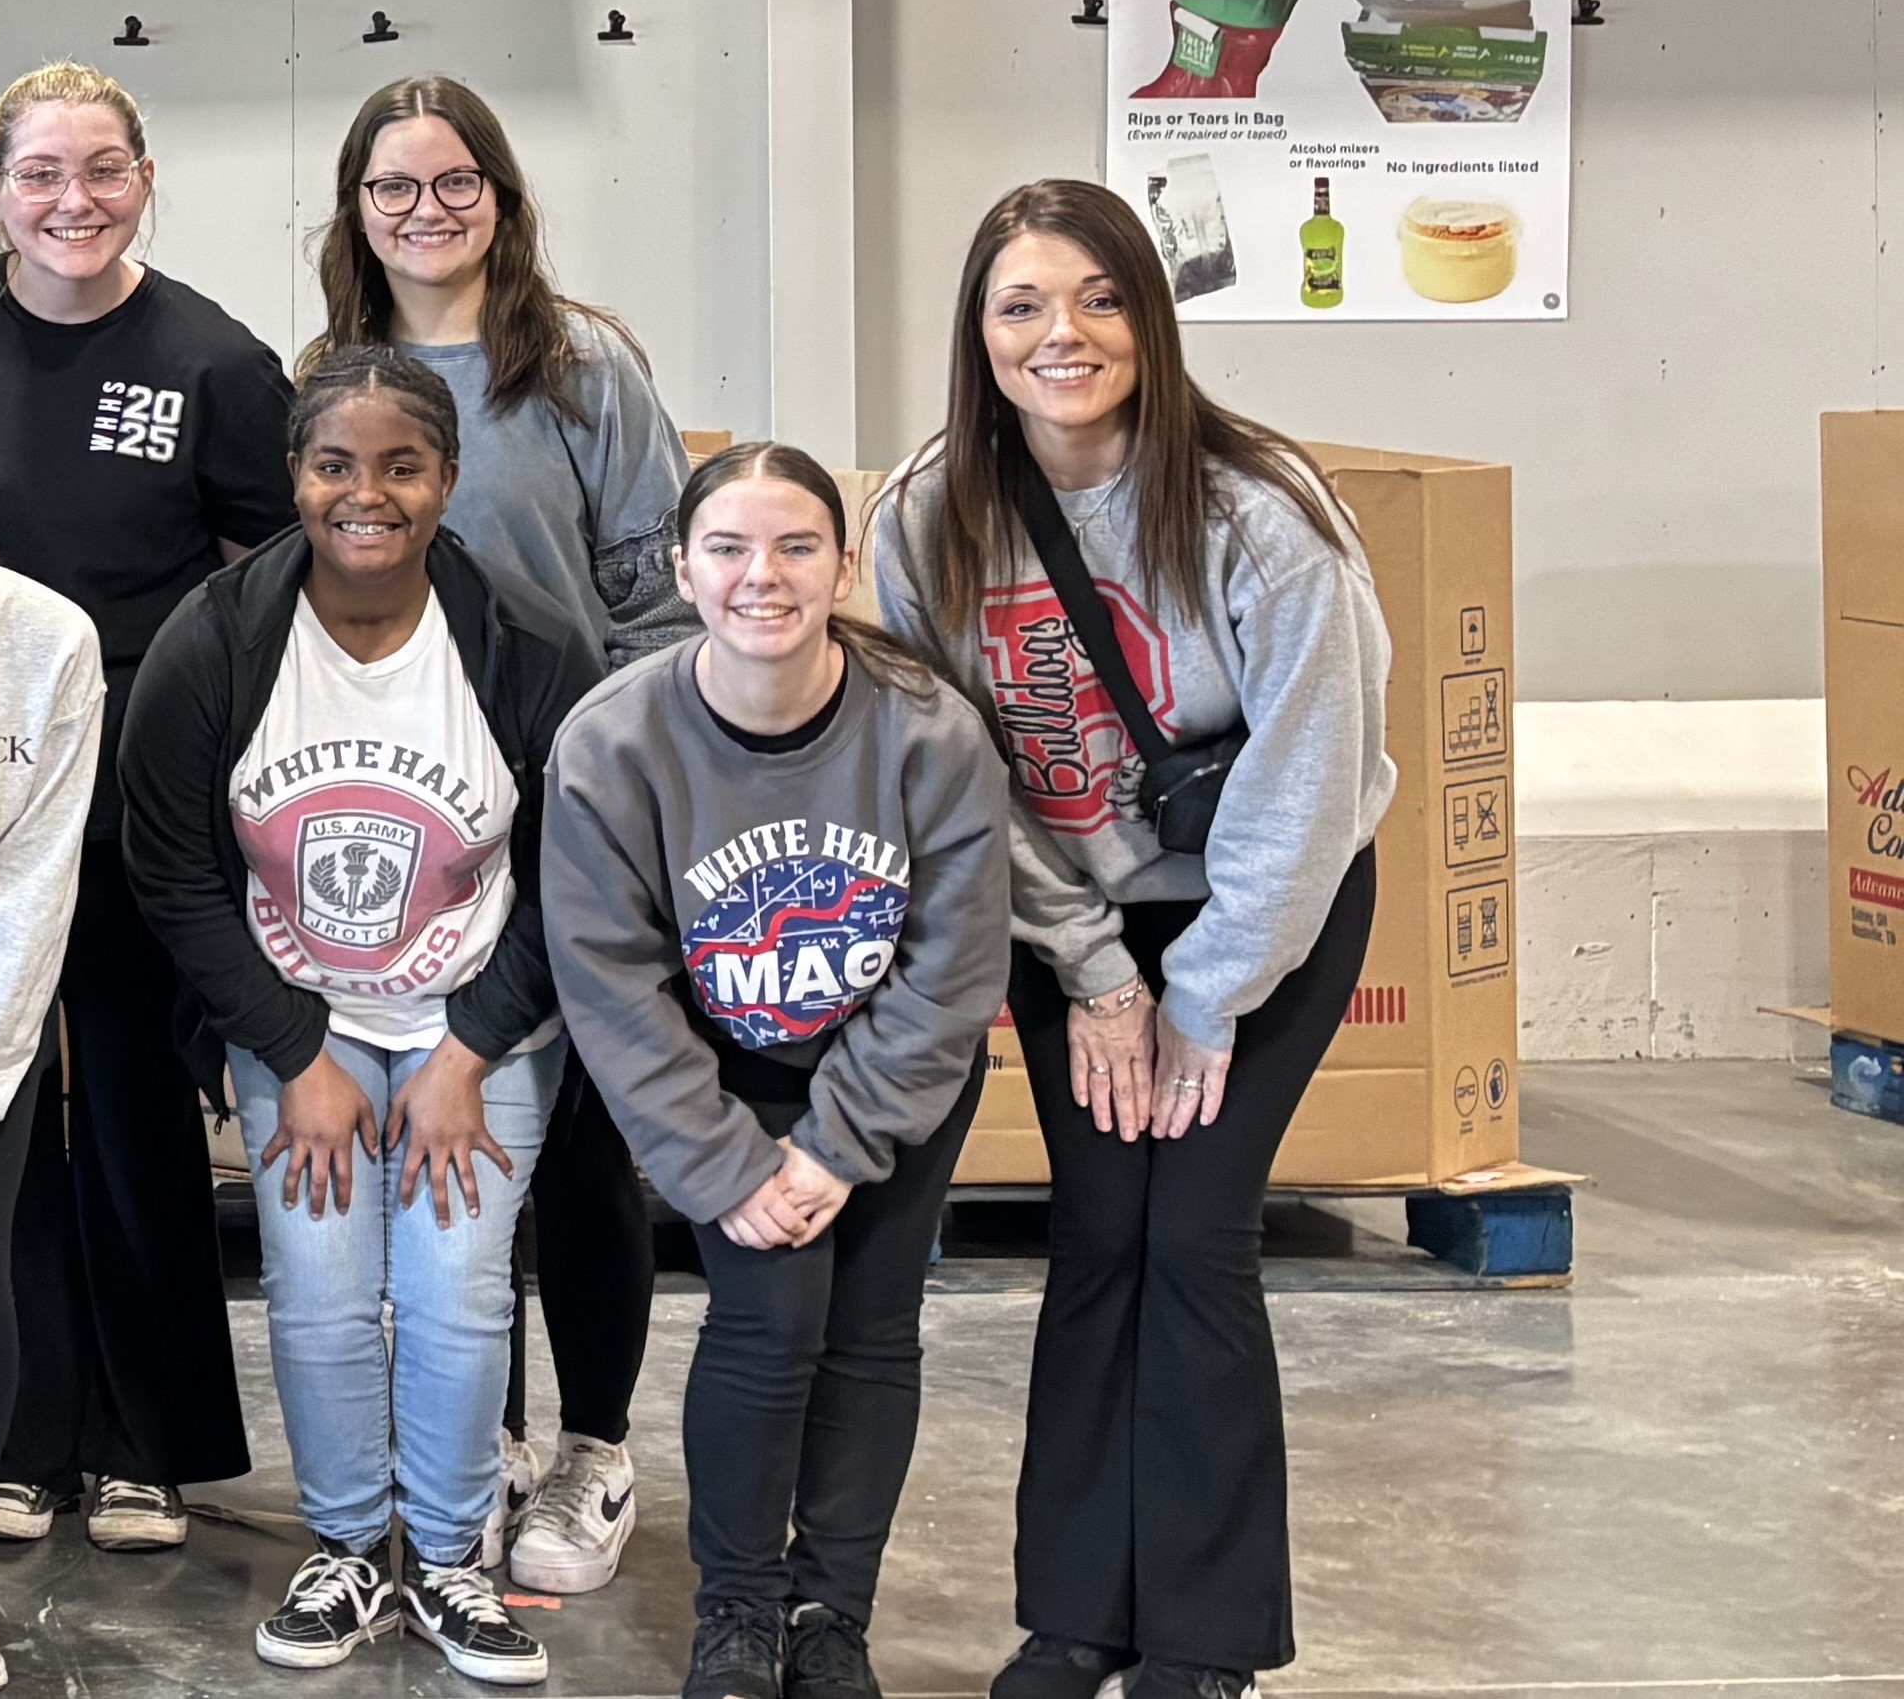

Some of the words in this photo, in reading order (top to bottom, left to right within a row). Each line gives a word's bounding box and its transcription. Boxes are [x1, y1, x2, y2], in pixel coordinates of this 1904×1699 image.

[1128, 112, 1162, 128] Rips
[1166, 115, 1183, 126] or
[1188, 112, 1230, 126] Tears
[1234, 112, 1249, 126] in
[1254, 112, 1284, 129] Bag
[1128, 129, 1159, 141] (Even
[1163, 129, 1174, 140] if
[1177, 129, 1227, 142] repaired
[1231, 131, 1244, 140] or
[1247, 129, 1287, 142] taped)
[1290, 144, 1337, 155] Alcohol
[1340, 143, 1380, 155] mixers
[1290, 160, 1301, 169] or
[1306, 158, 1366, 171] flavorings
[1386, 161, 1407, 173] No
[1411, 160, 1495, 176] ingredients
[1499, 160, 1539, 173] listed
[122, 385, 184, 424] 20
[90, 381, 126, 451] WHHS
[115, 422, 179, 463] 25
[240, 740, 382, 807] WHITE
[389, 745, 489, 838] HALL
[313, 821, 347, 836] U.S.
[353, 820, 411, 842] ARMY
[684, 819, 810, 901] WHITE
